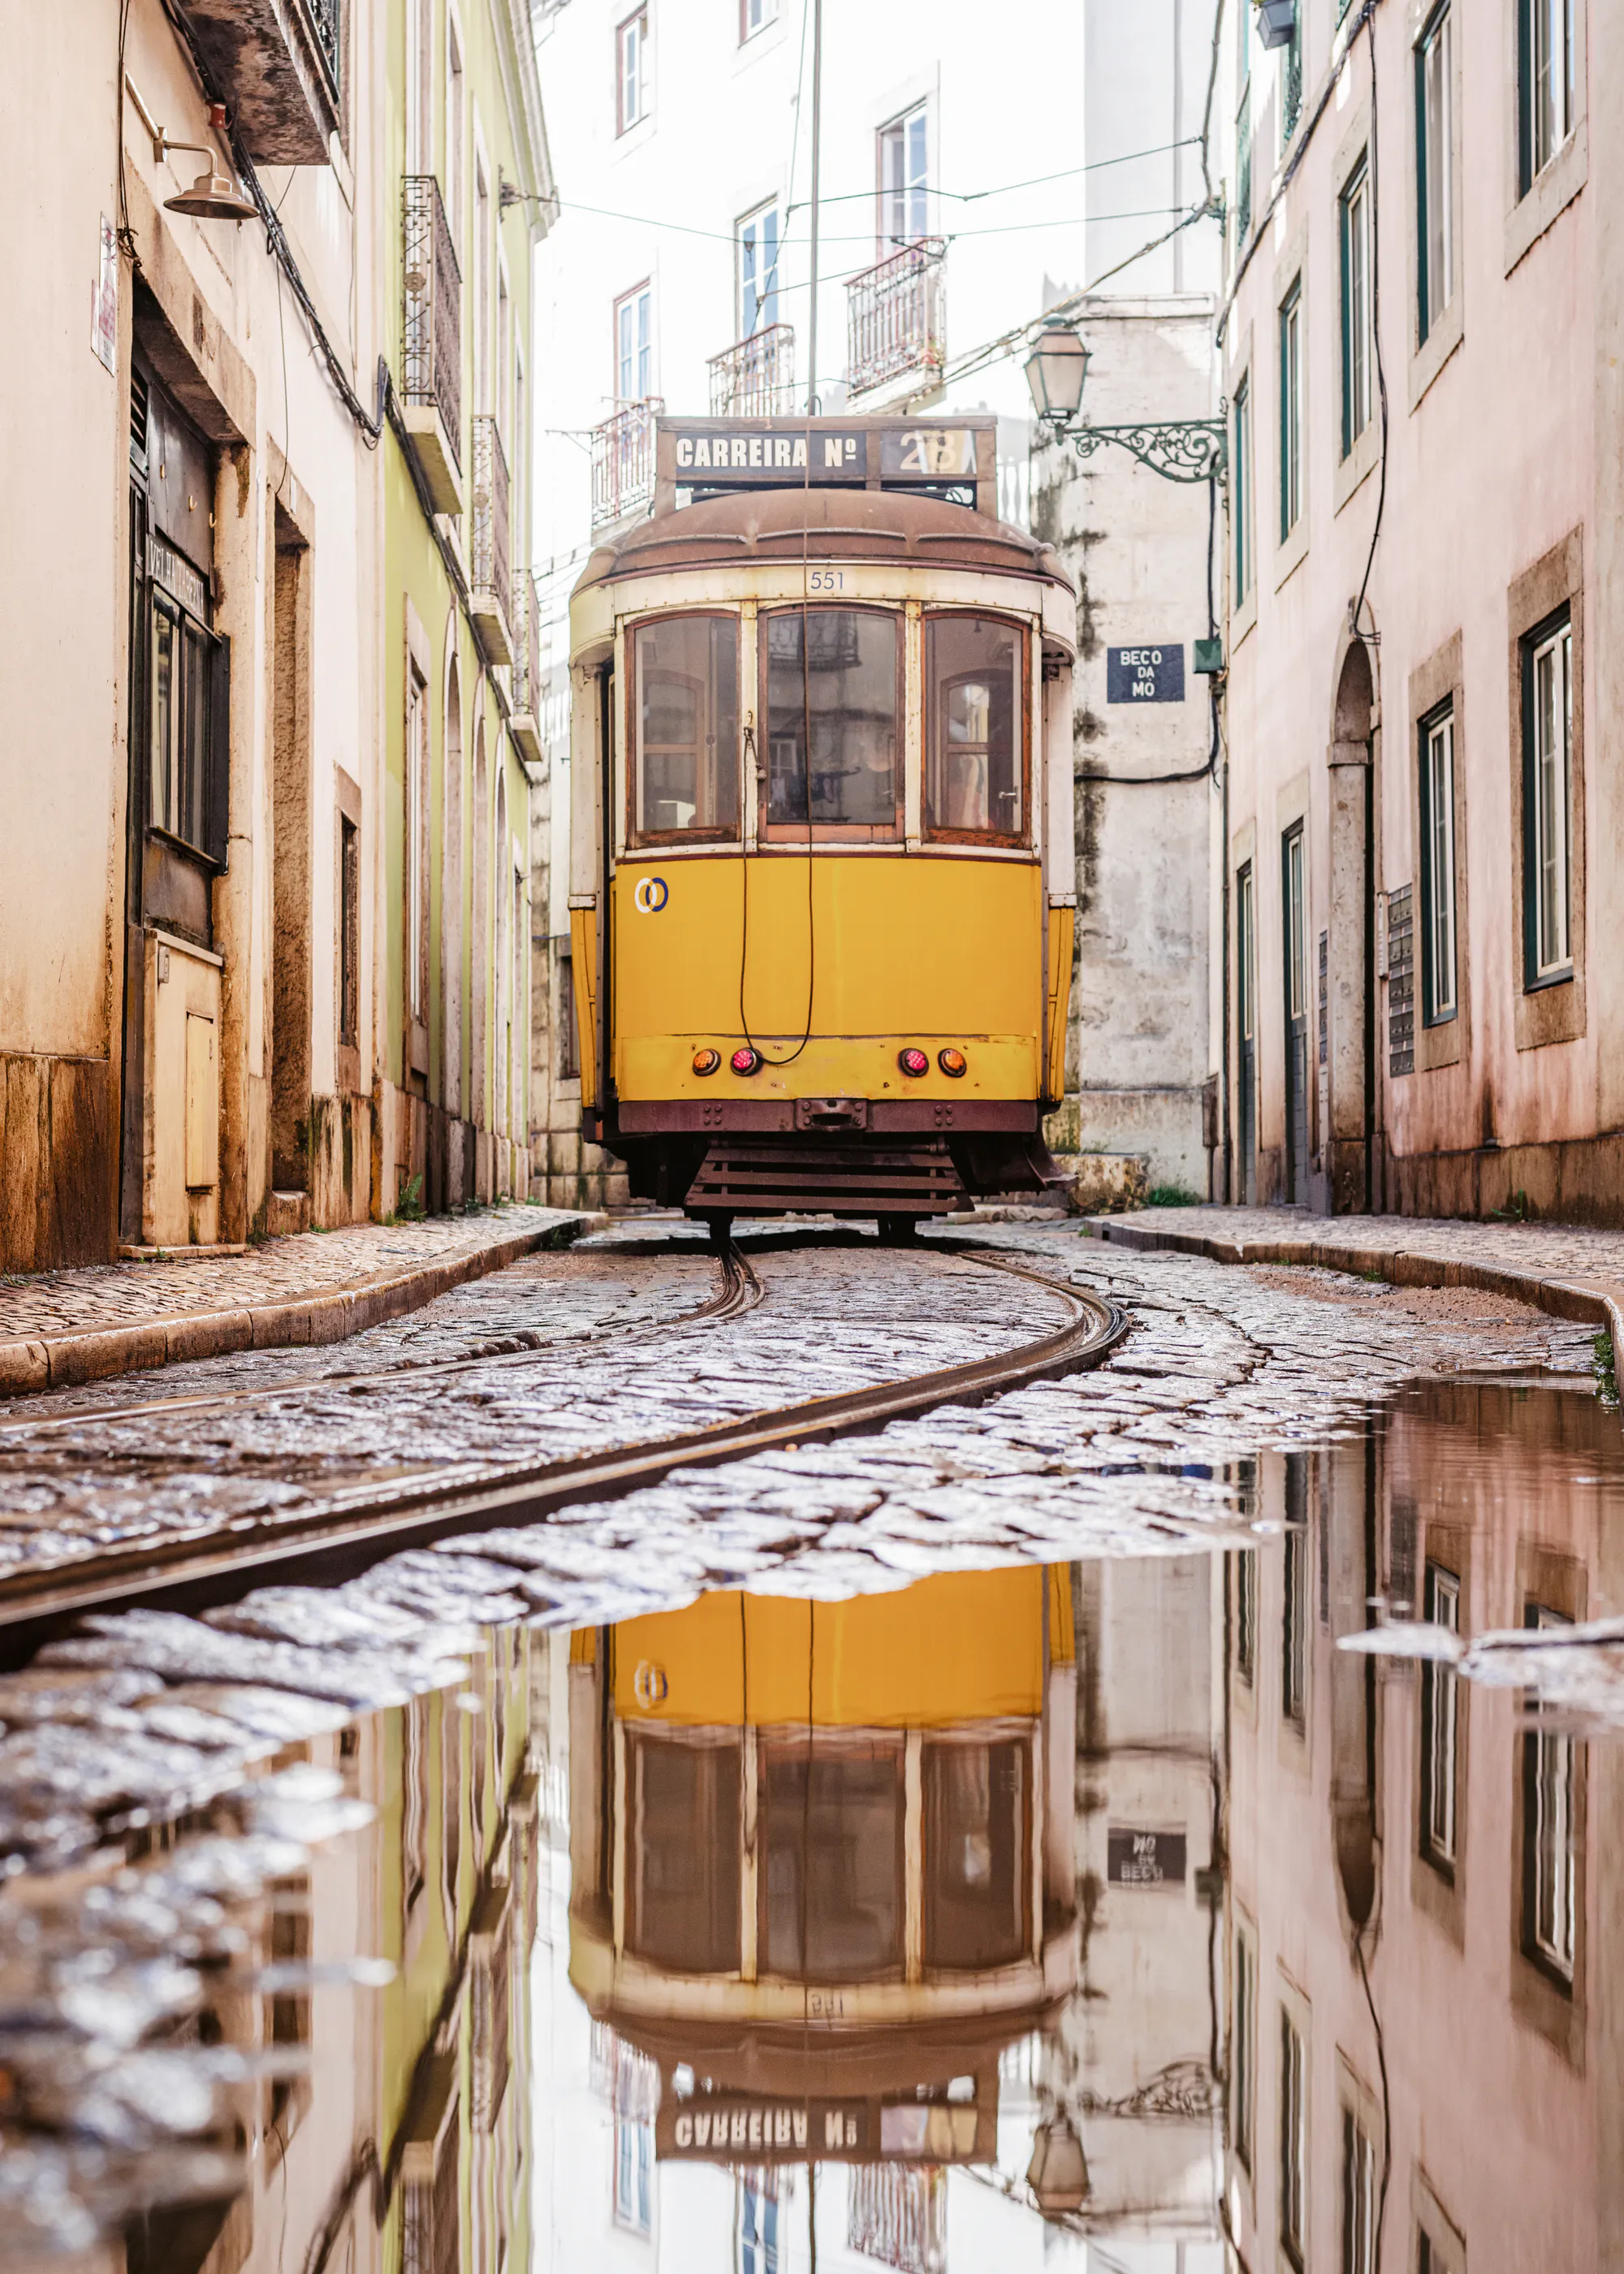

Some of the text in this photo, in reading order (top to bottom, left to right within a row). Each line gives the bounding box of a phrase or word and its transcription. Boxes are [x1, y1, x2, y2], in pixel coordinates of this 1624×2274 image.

[676, 438, 808, 467] CARREIRA
[150, 539, 176, 596] VELHA
[810, 571, 844, 590] 551
[1121, 650, 1163, 666] BECO
[1138, 666, 1155, 679] DA
